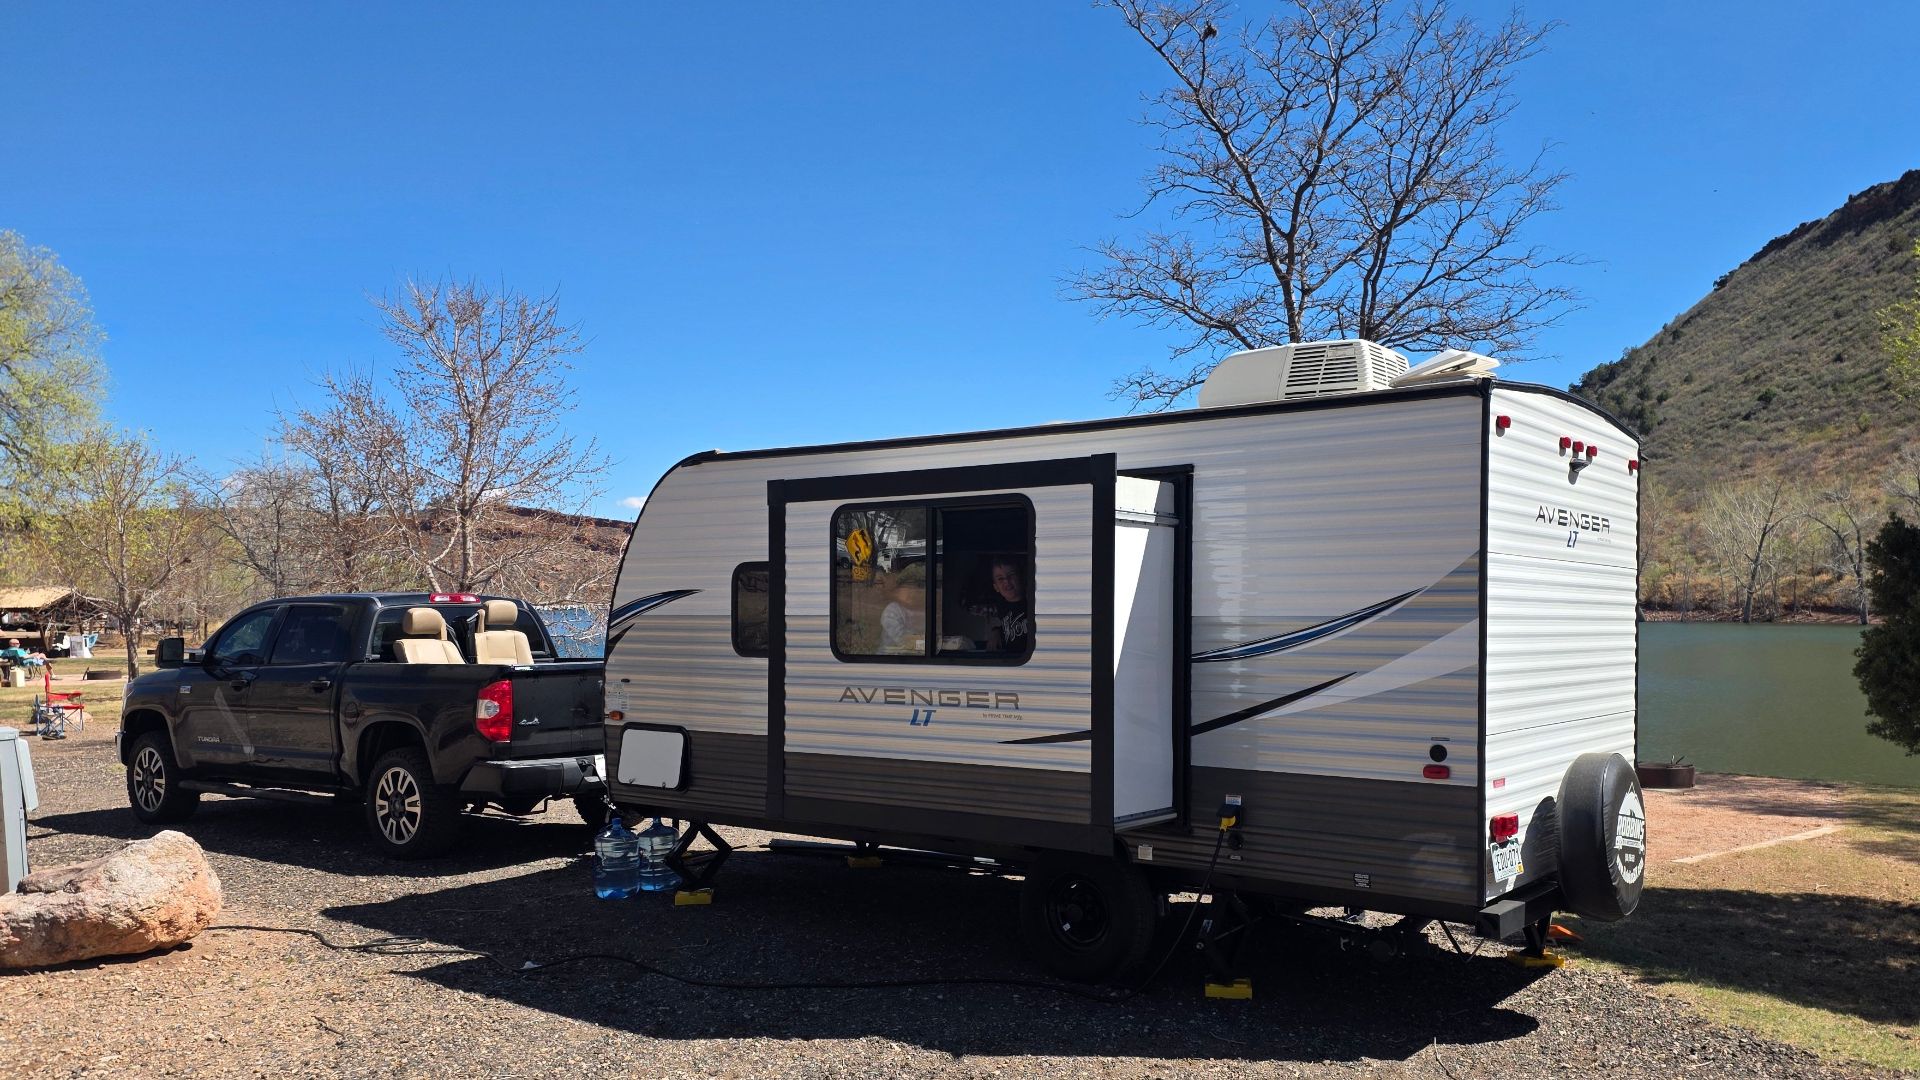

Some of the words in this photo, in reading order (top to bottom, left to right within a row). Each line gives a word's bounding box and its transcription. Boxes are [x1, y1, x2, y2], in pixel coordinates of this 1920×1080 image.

[1535, 505, 1610, 534] AVENGER
[1566, 530, 1579, 548] LT
[838, 686, 1020, 710] AVENGER
[909, 708, 937, 727] LT
